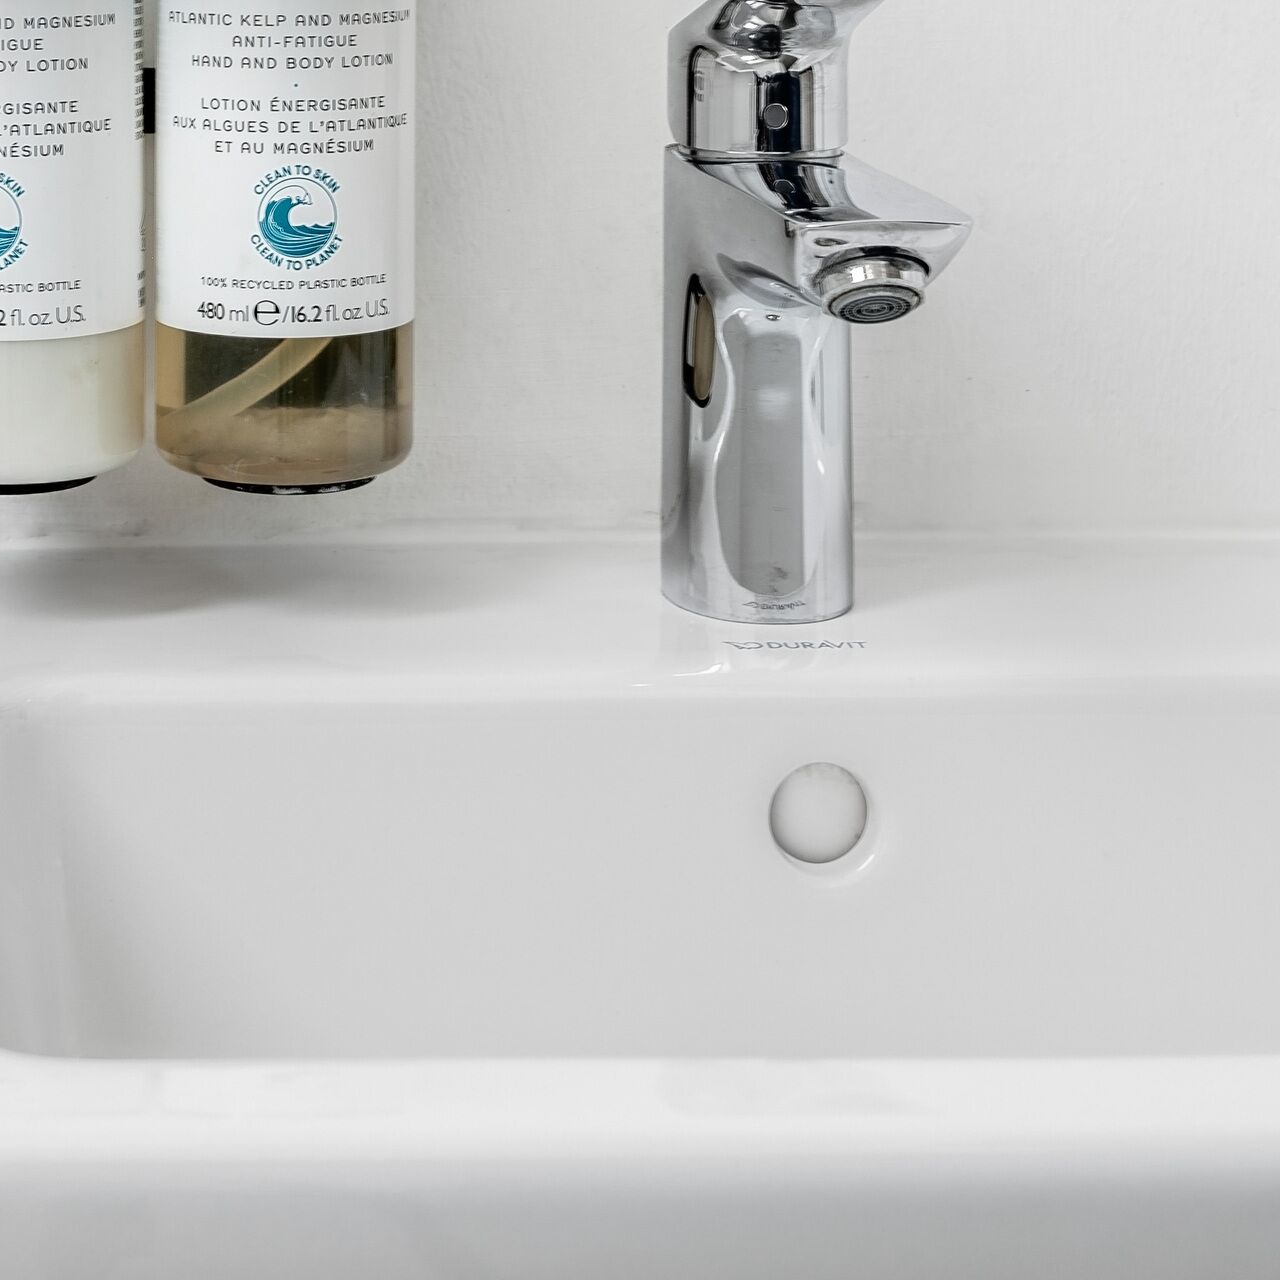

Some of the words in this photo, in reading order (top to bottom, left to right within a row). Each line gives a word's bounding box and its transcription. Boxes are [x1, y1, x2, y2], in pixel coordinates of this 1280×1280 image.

[24, 14, 115, 29] MAGNESIUM
[169, 11, 232, 25] ATLANTIC
[241, 15, 286, 26] KELP
[295, 14, 331, 26] AND
[233, 35, 357, 47] ANTI-FATIGUE
[27, 58, 88, 72] LOTION
[192, 55, 232, 68] HAND
[241, 57, 277, 69] AND
[286, 57, 334, 69] BODY
[342, 54, 393, 68] LOTION
[202, 98, 260, 111] LOTION
[270, 96, 385, 111] ÉNERGISANTE
[174, 116, 196, 129] AUX
[203, 119, 269, 133] ALGUES
[278, 121, 301, 133] DE
[310, 113, 407, 132] L'ATLANTIQUE
[215, 141, 232, 152] ET
[241, 142, 264, 154] AU
[274, 138, 374, 154] MAGNÉSIUM
[254, 166, 291, 195] CLEAN
[294, 164, 312, 176] TO
[314, 169, 341, 194] SKIN
[251, 234, 282, 269] CLEAN
[287, 259, 304, 271] TO
[306, 235, 342, 270] PLANET
[38, 280, 81, 292] BOTTLE
[201, 277, 227, 288] 100%
[232, 279, 294, 290] RECYCLED
[299, 279, 347, 289] PLASTIC
[350, 274, 386, 287] BOTTLE
[197, 302, 225, 320] 480
[229, 305, 249, 322] ml
[766, 640, 867, 650] DURAVIT
